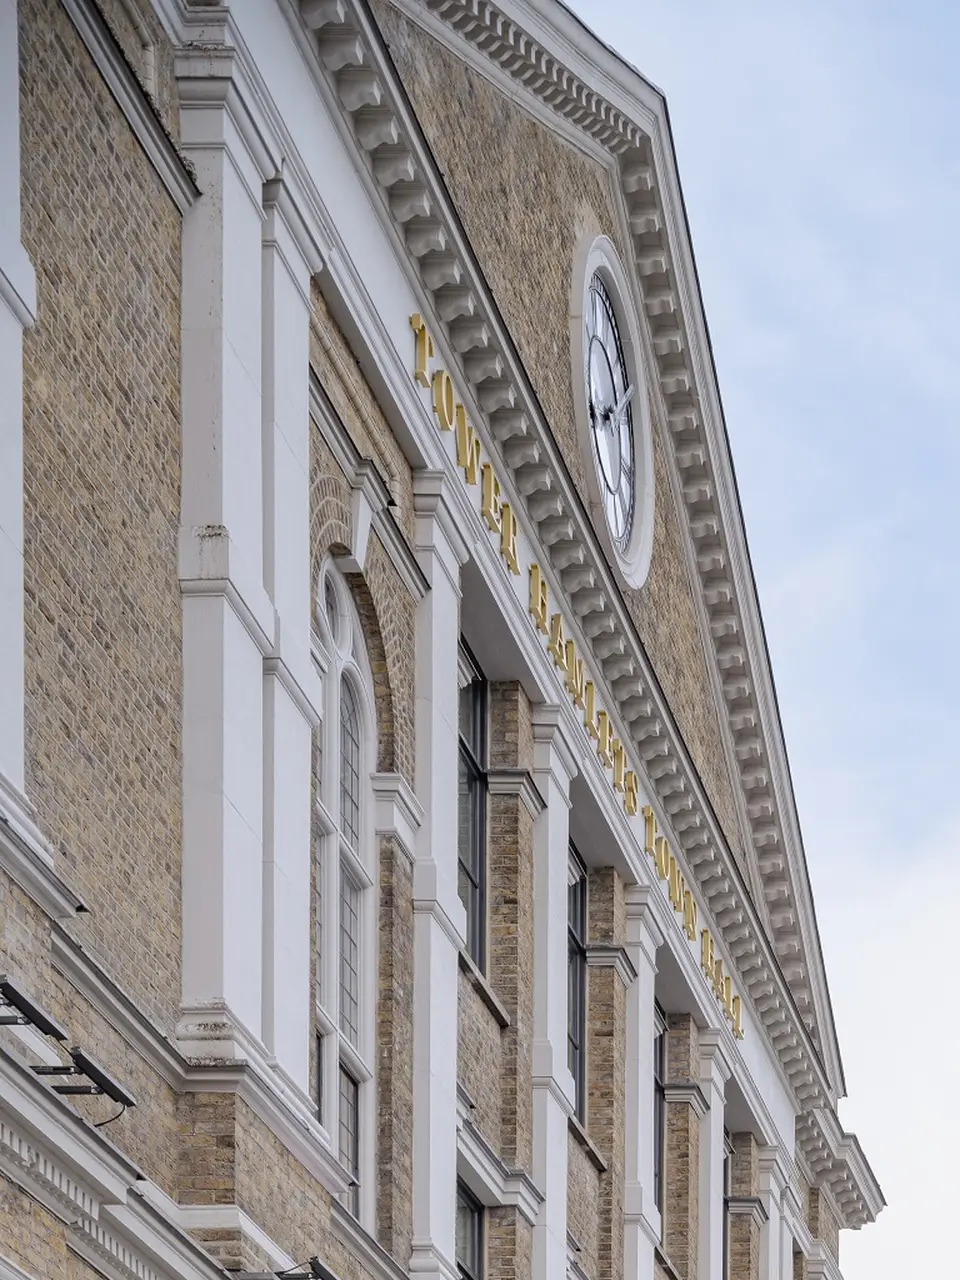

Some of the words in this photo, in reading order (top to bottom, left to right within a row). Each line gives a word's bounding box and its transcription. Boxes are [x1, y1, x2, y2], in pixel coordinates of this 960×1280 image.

[408, 313, 521, 576] TOWER
[528, 562, 639, 817] HAMLETS
[642, 804, 698, 942] TOWN
[701, 928, 744, 1041] HALL
